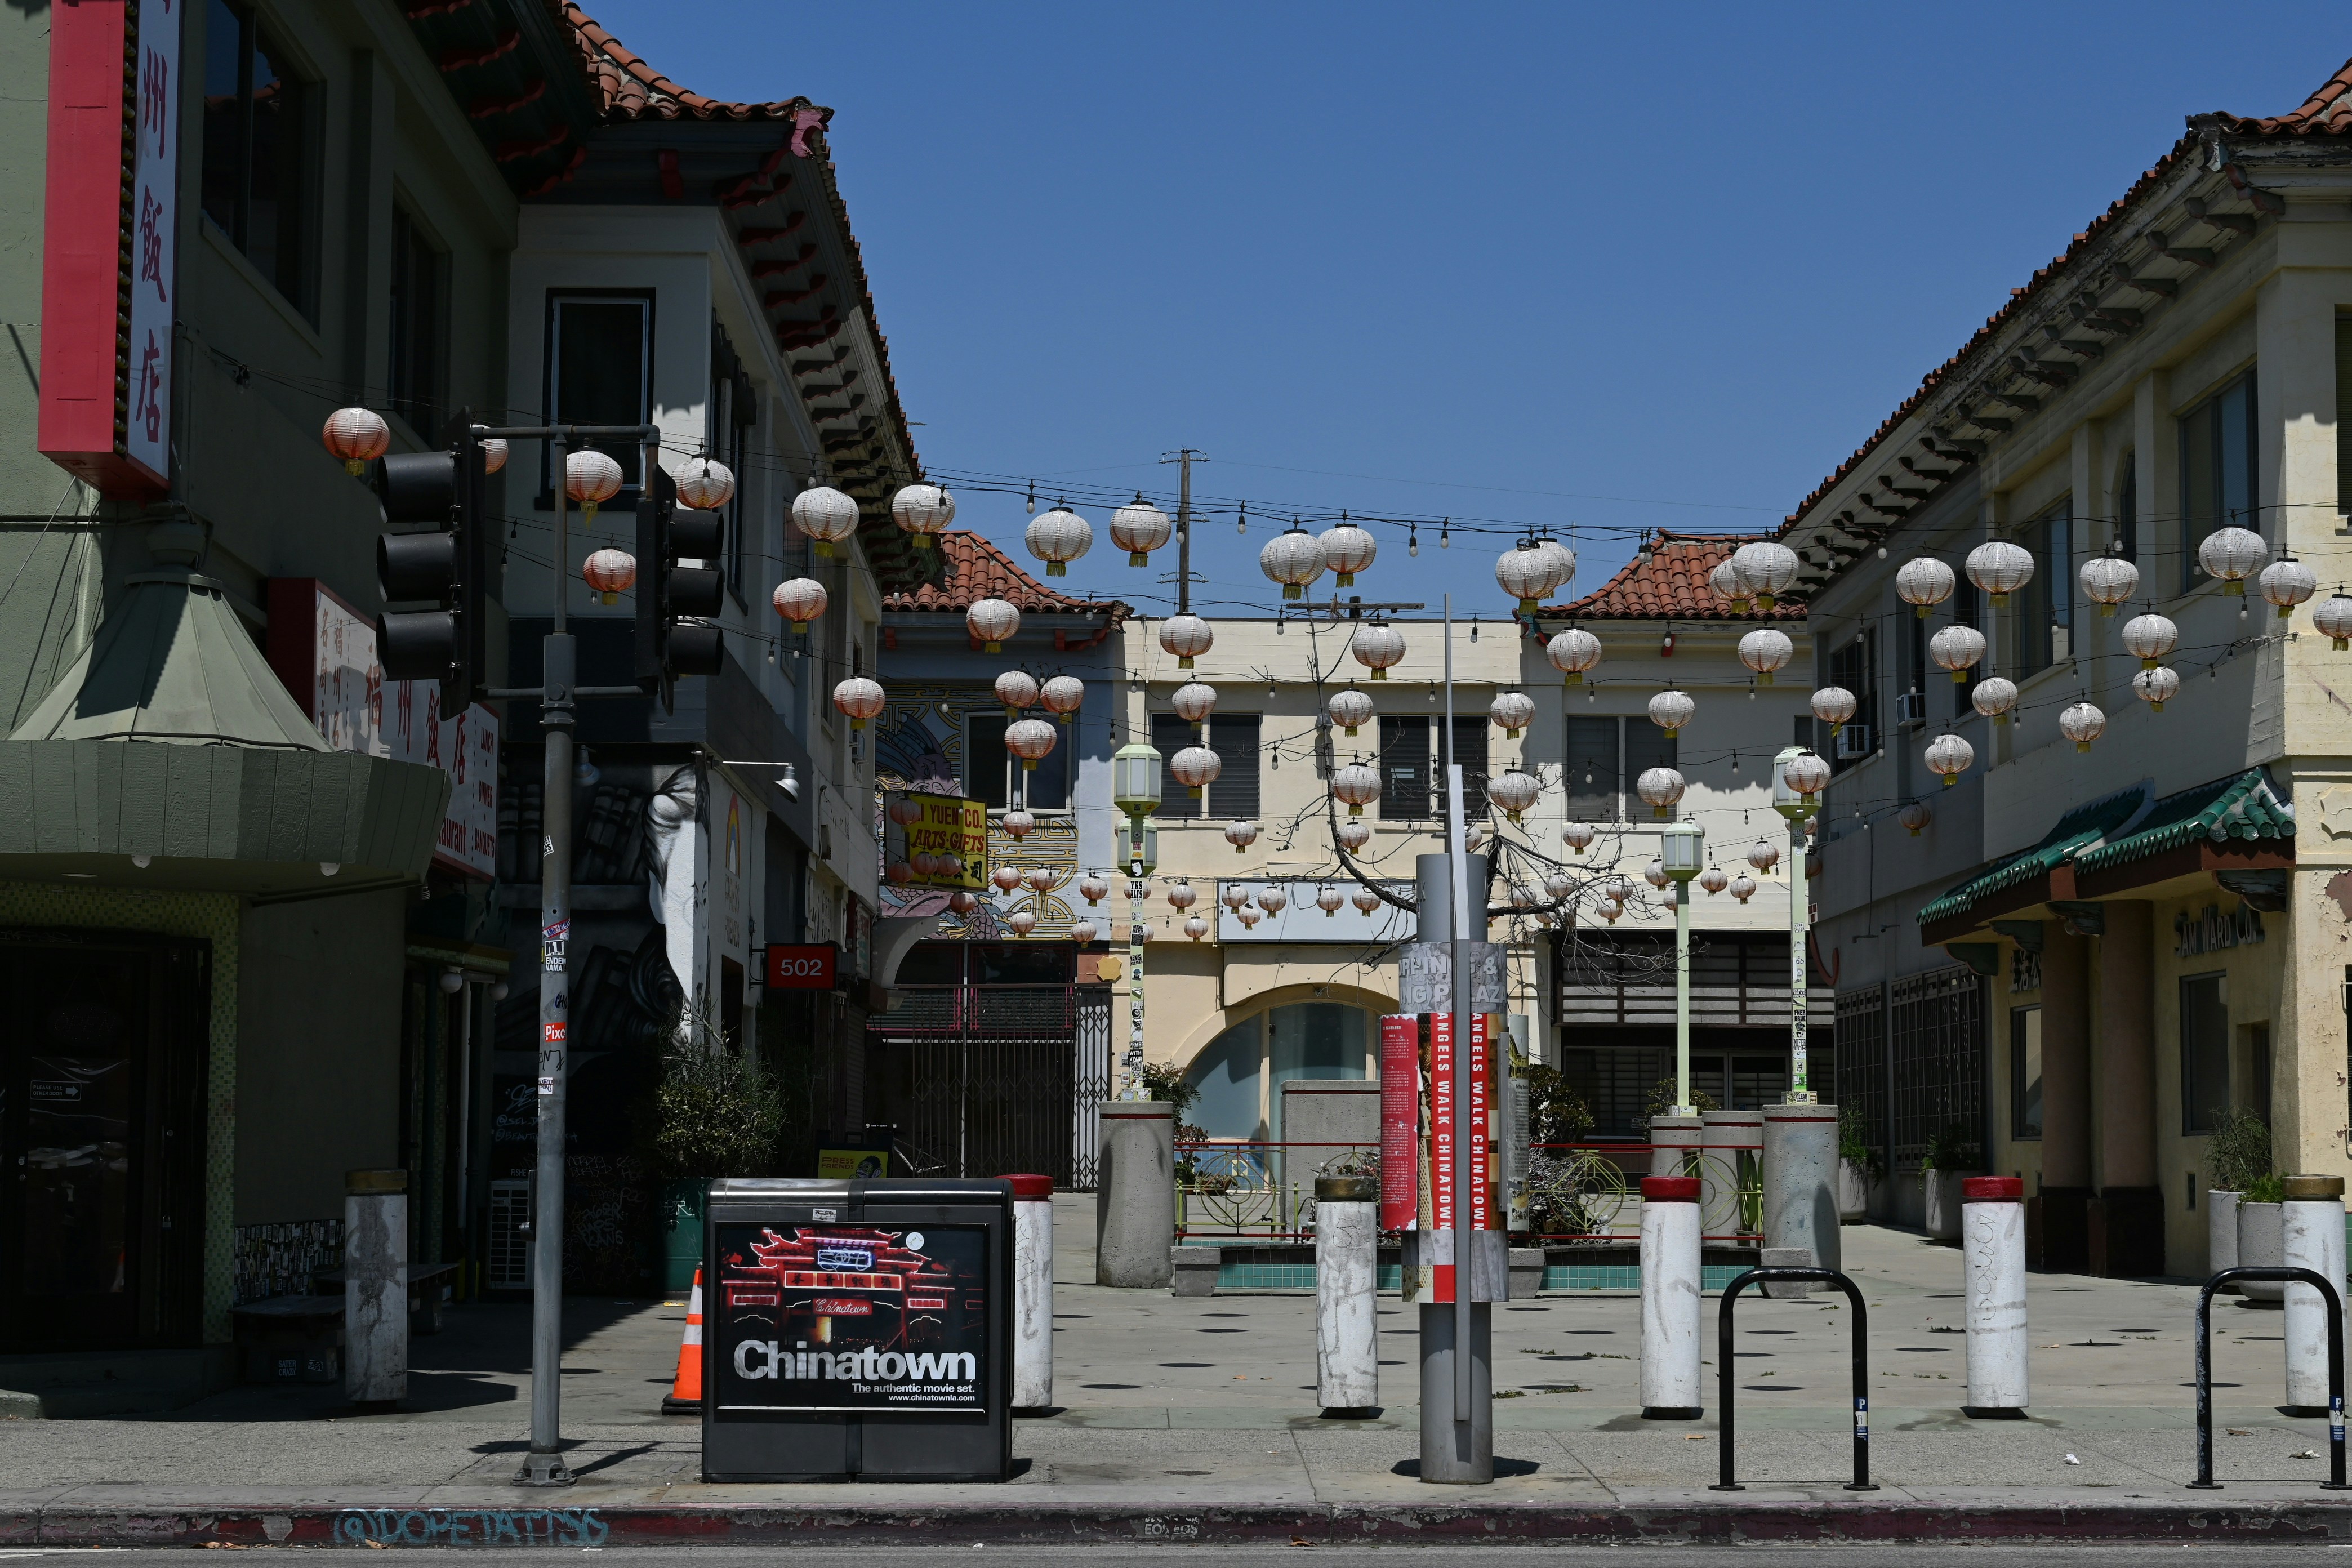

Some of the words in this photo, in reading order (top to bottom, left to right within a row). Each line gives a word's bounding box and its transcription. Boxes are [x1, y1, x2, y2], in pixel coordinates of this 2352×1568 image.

[136, 0, 169, 442] 州飯店
[480, 726, 493, 755] LUNCH
[478, 779, 493, 809] DINNER
[930, 804, 959, 826] YUEN
[964, 808, 983, 829] CO.
[474, 827, 495, 859] BANQUETS
[543, 843, 552, 853] CS
[1130, 881, 1143, 890] YKS
[2201, 906, 2233, 952] WARD
[780, 959, 823, 976] 502
[1437, 1012, 1450, 1071] ANGELS
[1472, 1013, 1483, 1072] ANGELS
[1438, 1080, 1450, 1125] WALK
[1472, 1081, 1484, 1125] WALK
[1438, 1134, 1451, 1230] CHINATOWN
[1472, 1134, 1485, 1230] CHINATOWN
[816, 1299, 870, 1314] Chinatown
[733, 1339, 976, 1380] Chinatown
[852, 1383, 871, 1393] The
[873, 1383, 921, 1393] authentic
[923, 1384, 955, 1393] movie
[956, 1384, 975, 1393] set.
[1859, 1398, 1865, 1409] P
[2335, 1397, 2342, 1409] P
